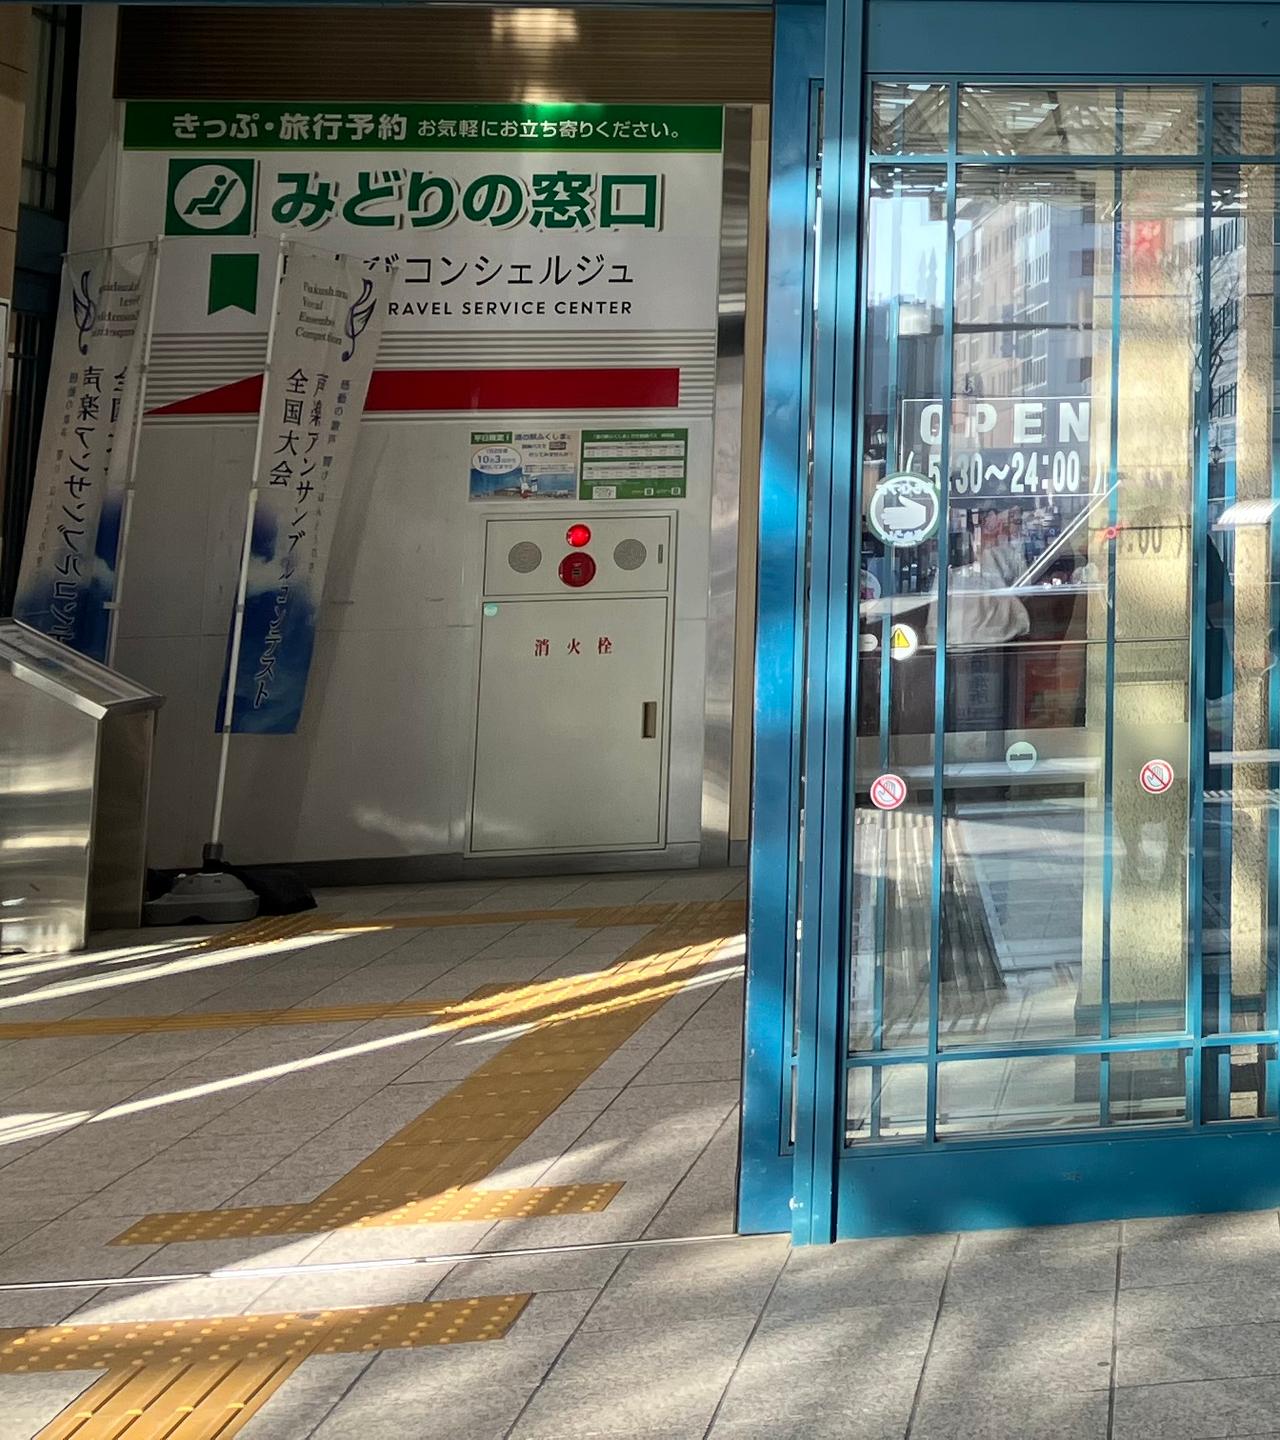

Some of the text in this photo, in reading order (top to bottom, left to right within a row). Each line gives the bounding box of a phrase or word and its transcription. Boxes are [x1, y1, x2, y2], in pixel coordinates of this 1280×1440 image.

[172, 112, 679, 141] きっぷ・旅行予約 お気軽にお立ち寄りください。
[271, 170, 658, 229] みどりの窓口
[388, 301, 633, 316] RAVEL SERVICE CENTER
[269, 367, 309, 488] 全国大会
[920, 402, 1090, 446] OPEN
[534, 637, 613, 657] 消火栓
